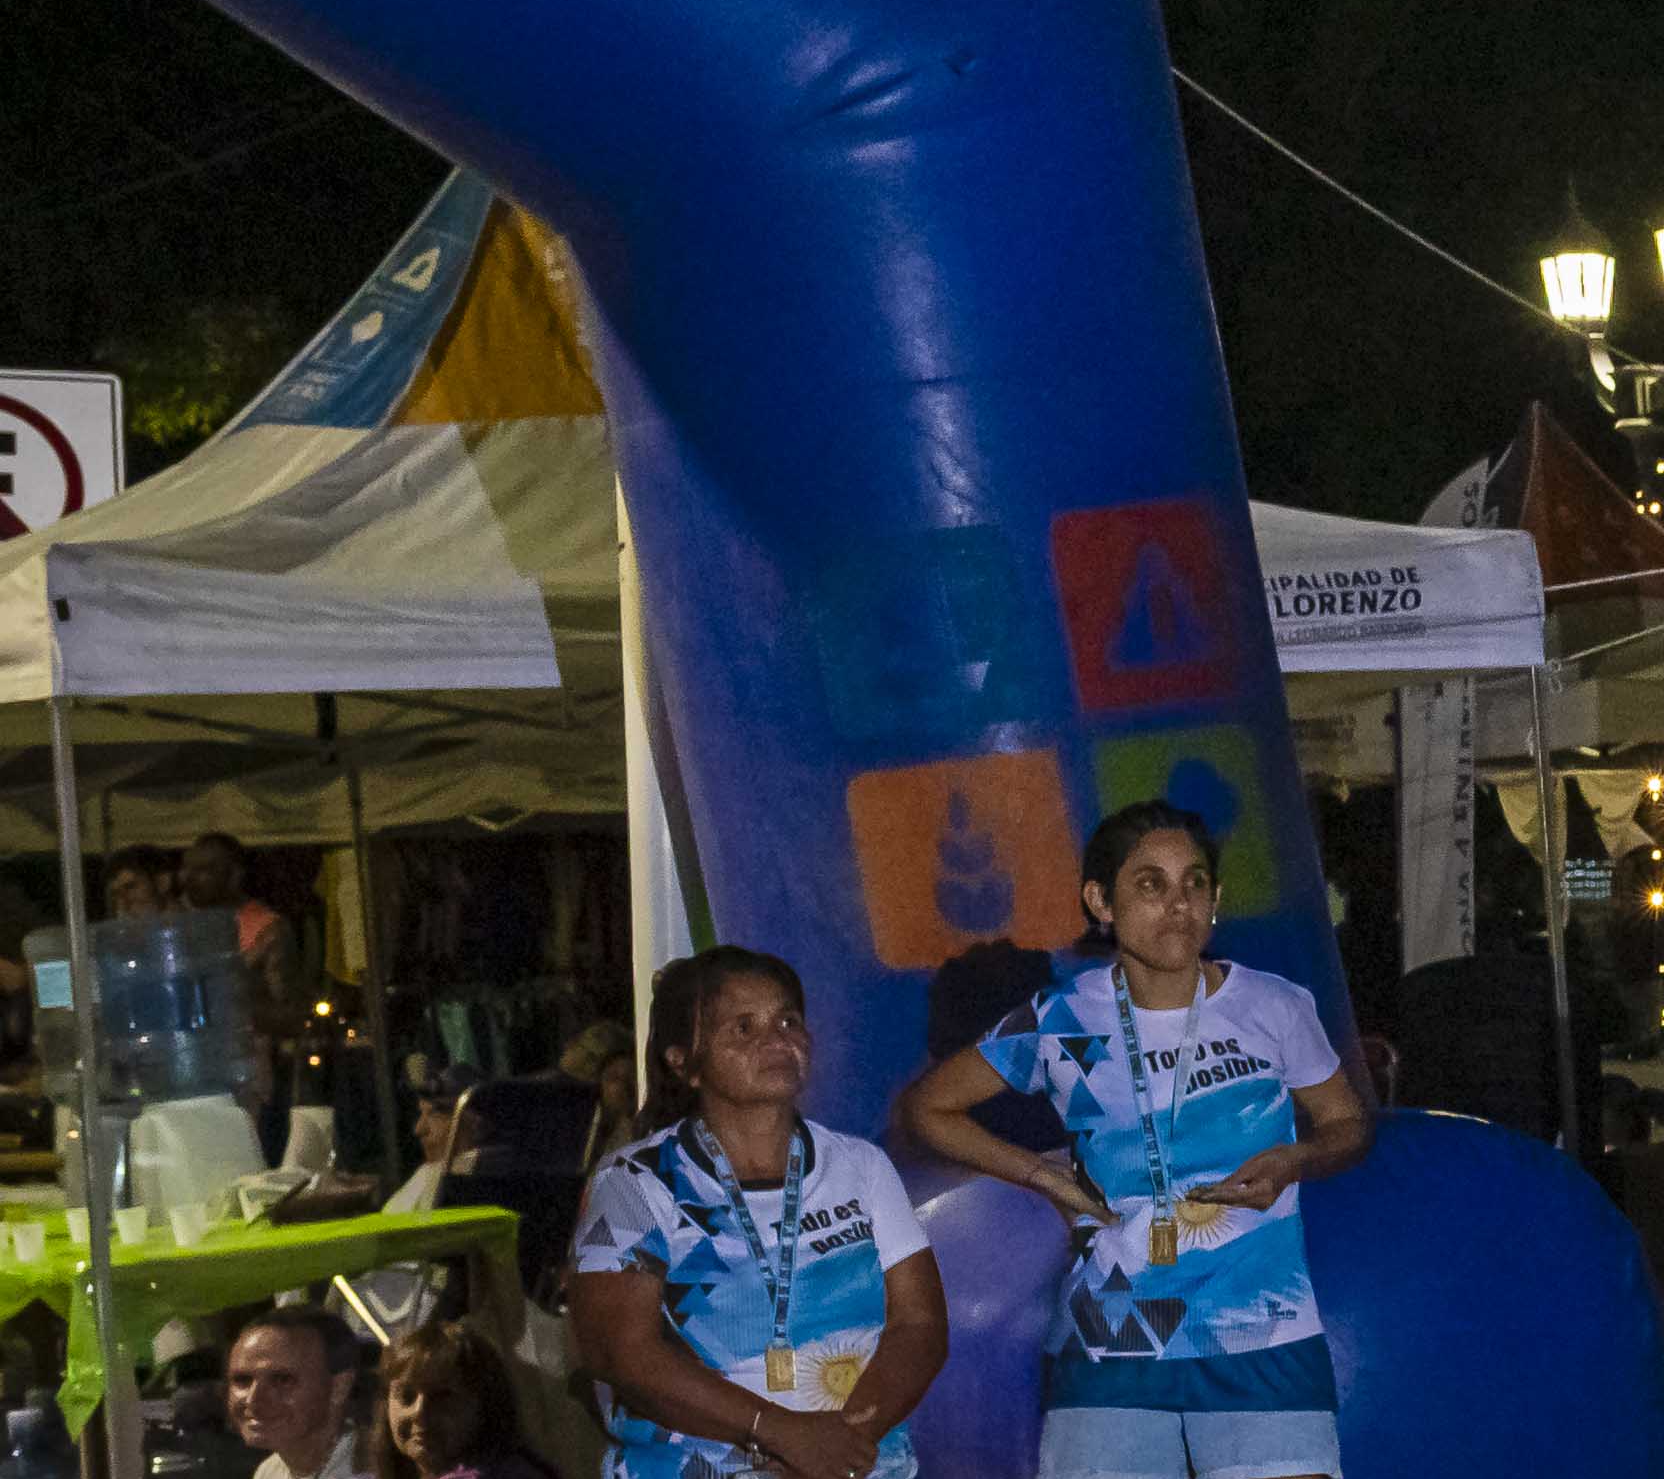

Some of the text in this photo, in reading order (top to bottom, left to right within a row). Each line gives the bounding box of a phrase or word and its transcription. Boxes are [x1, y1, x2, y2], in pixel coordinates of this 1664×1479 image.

[1264, 566, 1422, 591] IPALIDAD DE
[1273, 587, 1422, 618] LORENZO
[1210, 1037, 1242, 1058] es
[833, 1198, 864, 1219] es
